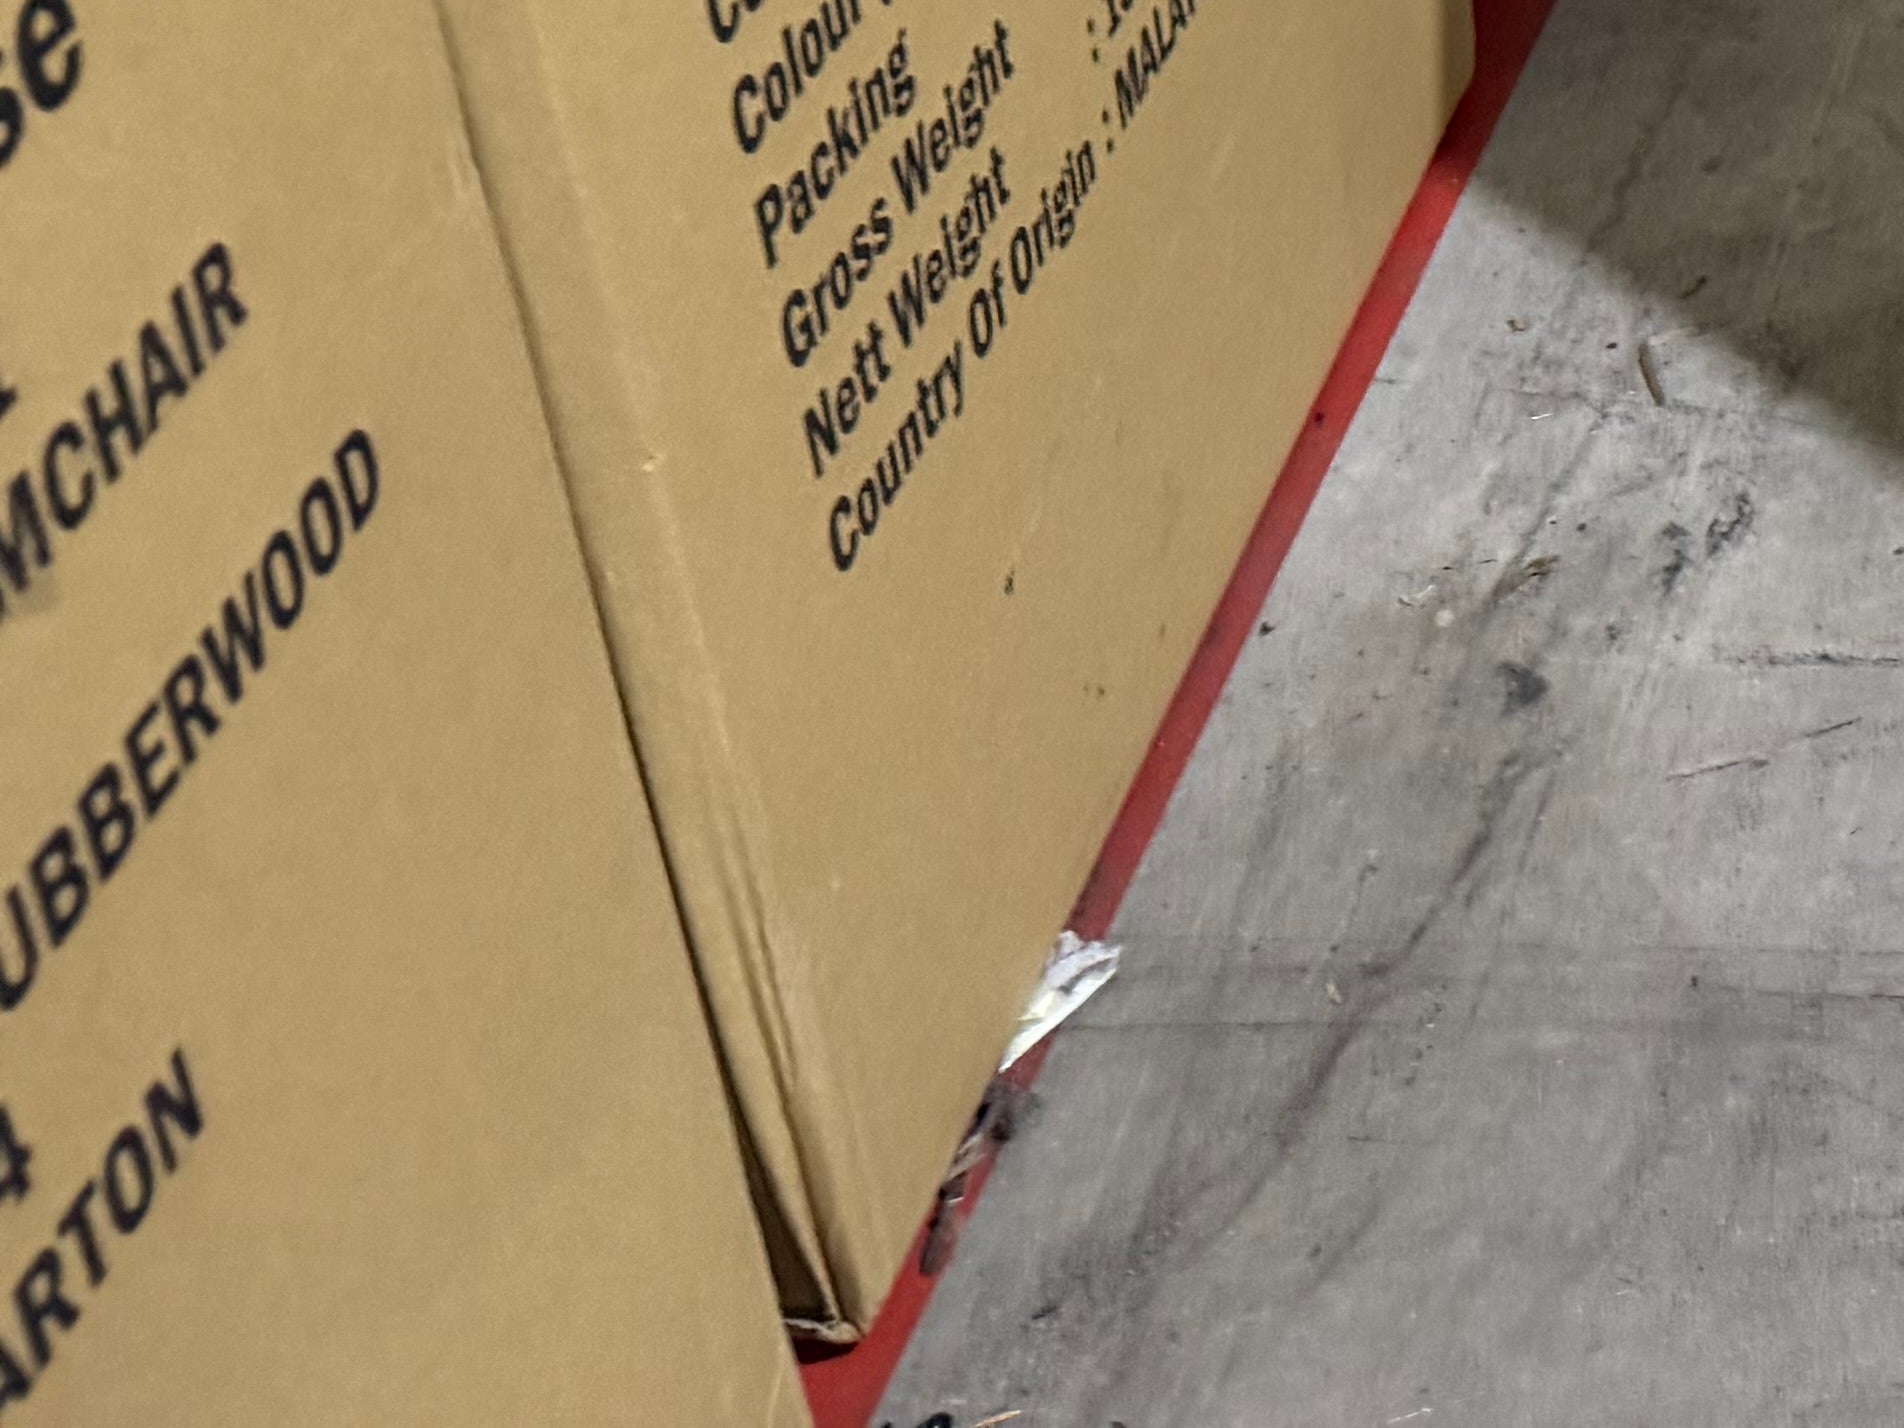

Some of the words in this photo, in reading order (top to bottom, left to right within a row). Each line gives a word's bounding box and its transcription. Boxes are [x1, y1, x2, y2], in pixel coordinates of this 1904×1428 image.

[753, 28, 917, 270] Packing
[780, 197, 894, 368] Gross
[890, 19, 1015, 216] Weight
[802, 319, 892, 479] Nett
[886, 145, 1011, 349] Weight
[0, 242, 249, 619] MCHAIR
[828, 340, 964, 572] Country
[967, 258, 1007, 359] Of
[1009, 140, 1097, 295] Origin
[0, 428, 380, 1014] UBBERWOOD
